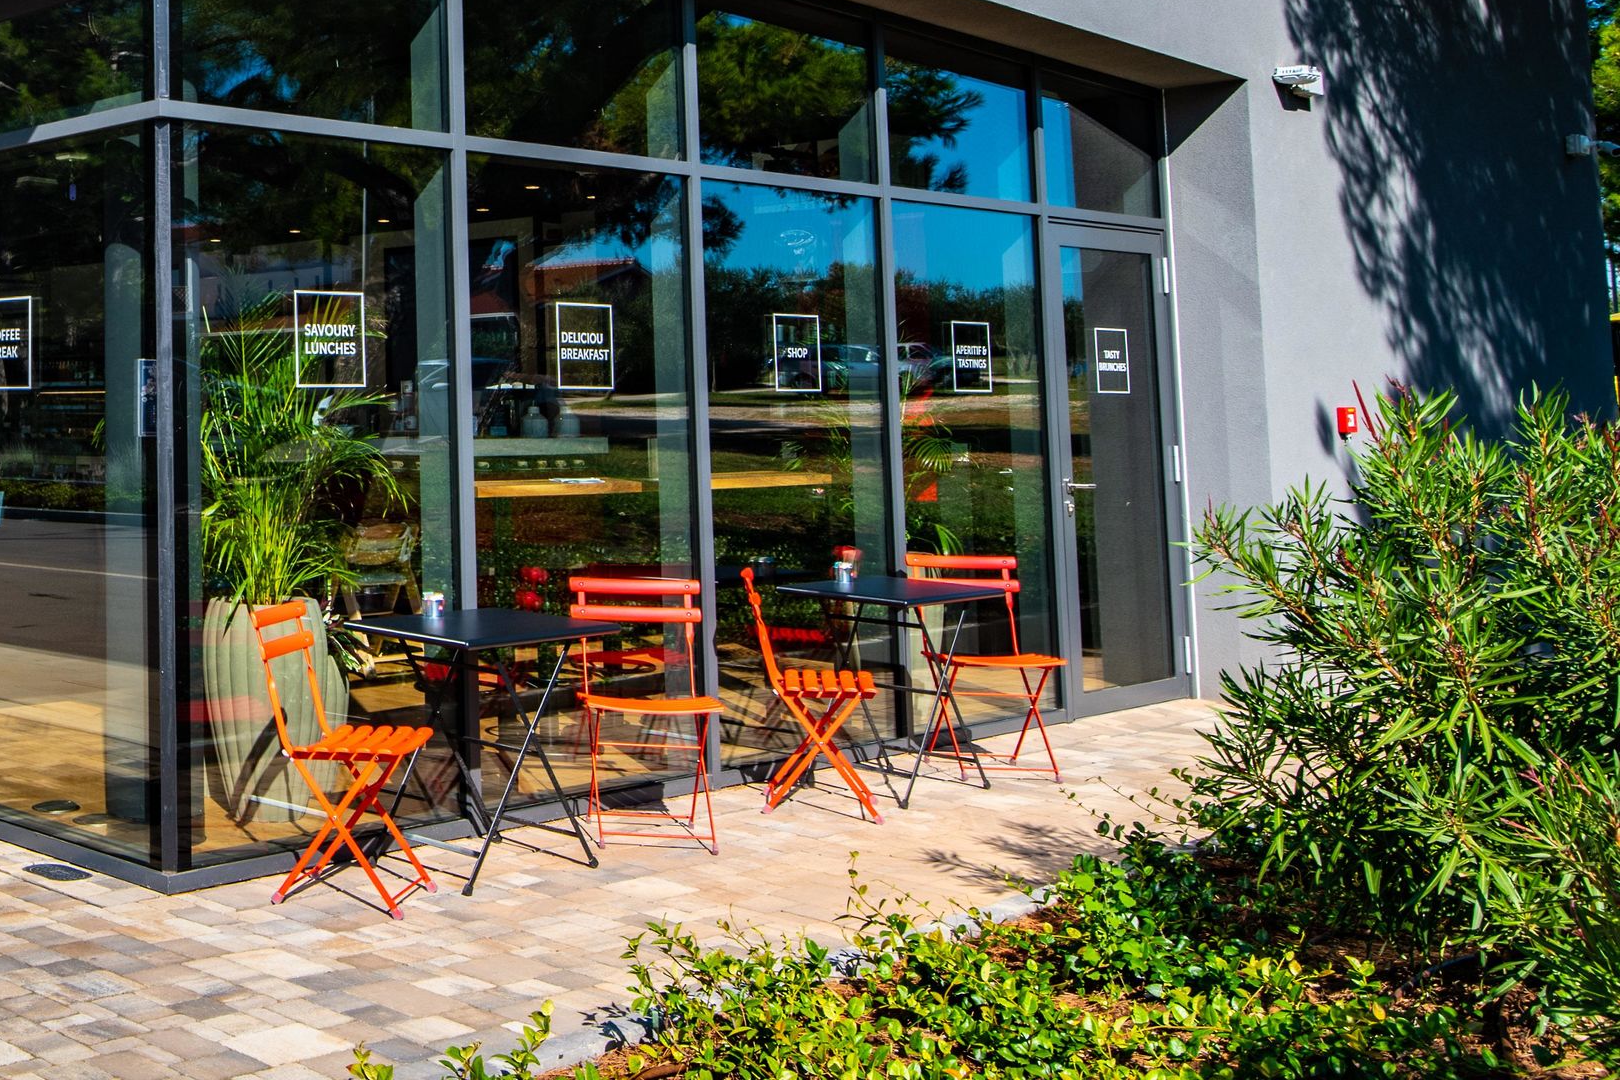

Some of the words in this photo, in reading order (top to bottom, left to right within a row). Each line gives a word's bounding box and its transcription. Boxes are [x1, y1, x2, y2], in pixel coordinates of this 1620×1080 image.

[304, 323, 356, 337] SAVOURY
[561, 331, 604, 345] DELICIOU
[305, 341, 356, 355] LUNCHES
[787, 347, 808, 358] SHOP
[956, 345, 982, 355] APERITIF
[982, 346, 987, 356] &
[561, 347, 609, 361] BREAKFAST
[1103, 350, 1120, 359] TASTY
[957, 358, 987, 369] TASTINGS
[1098, 362, 1127, 372] BRUNCHES
